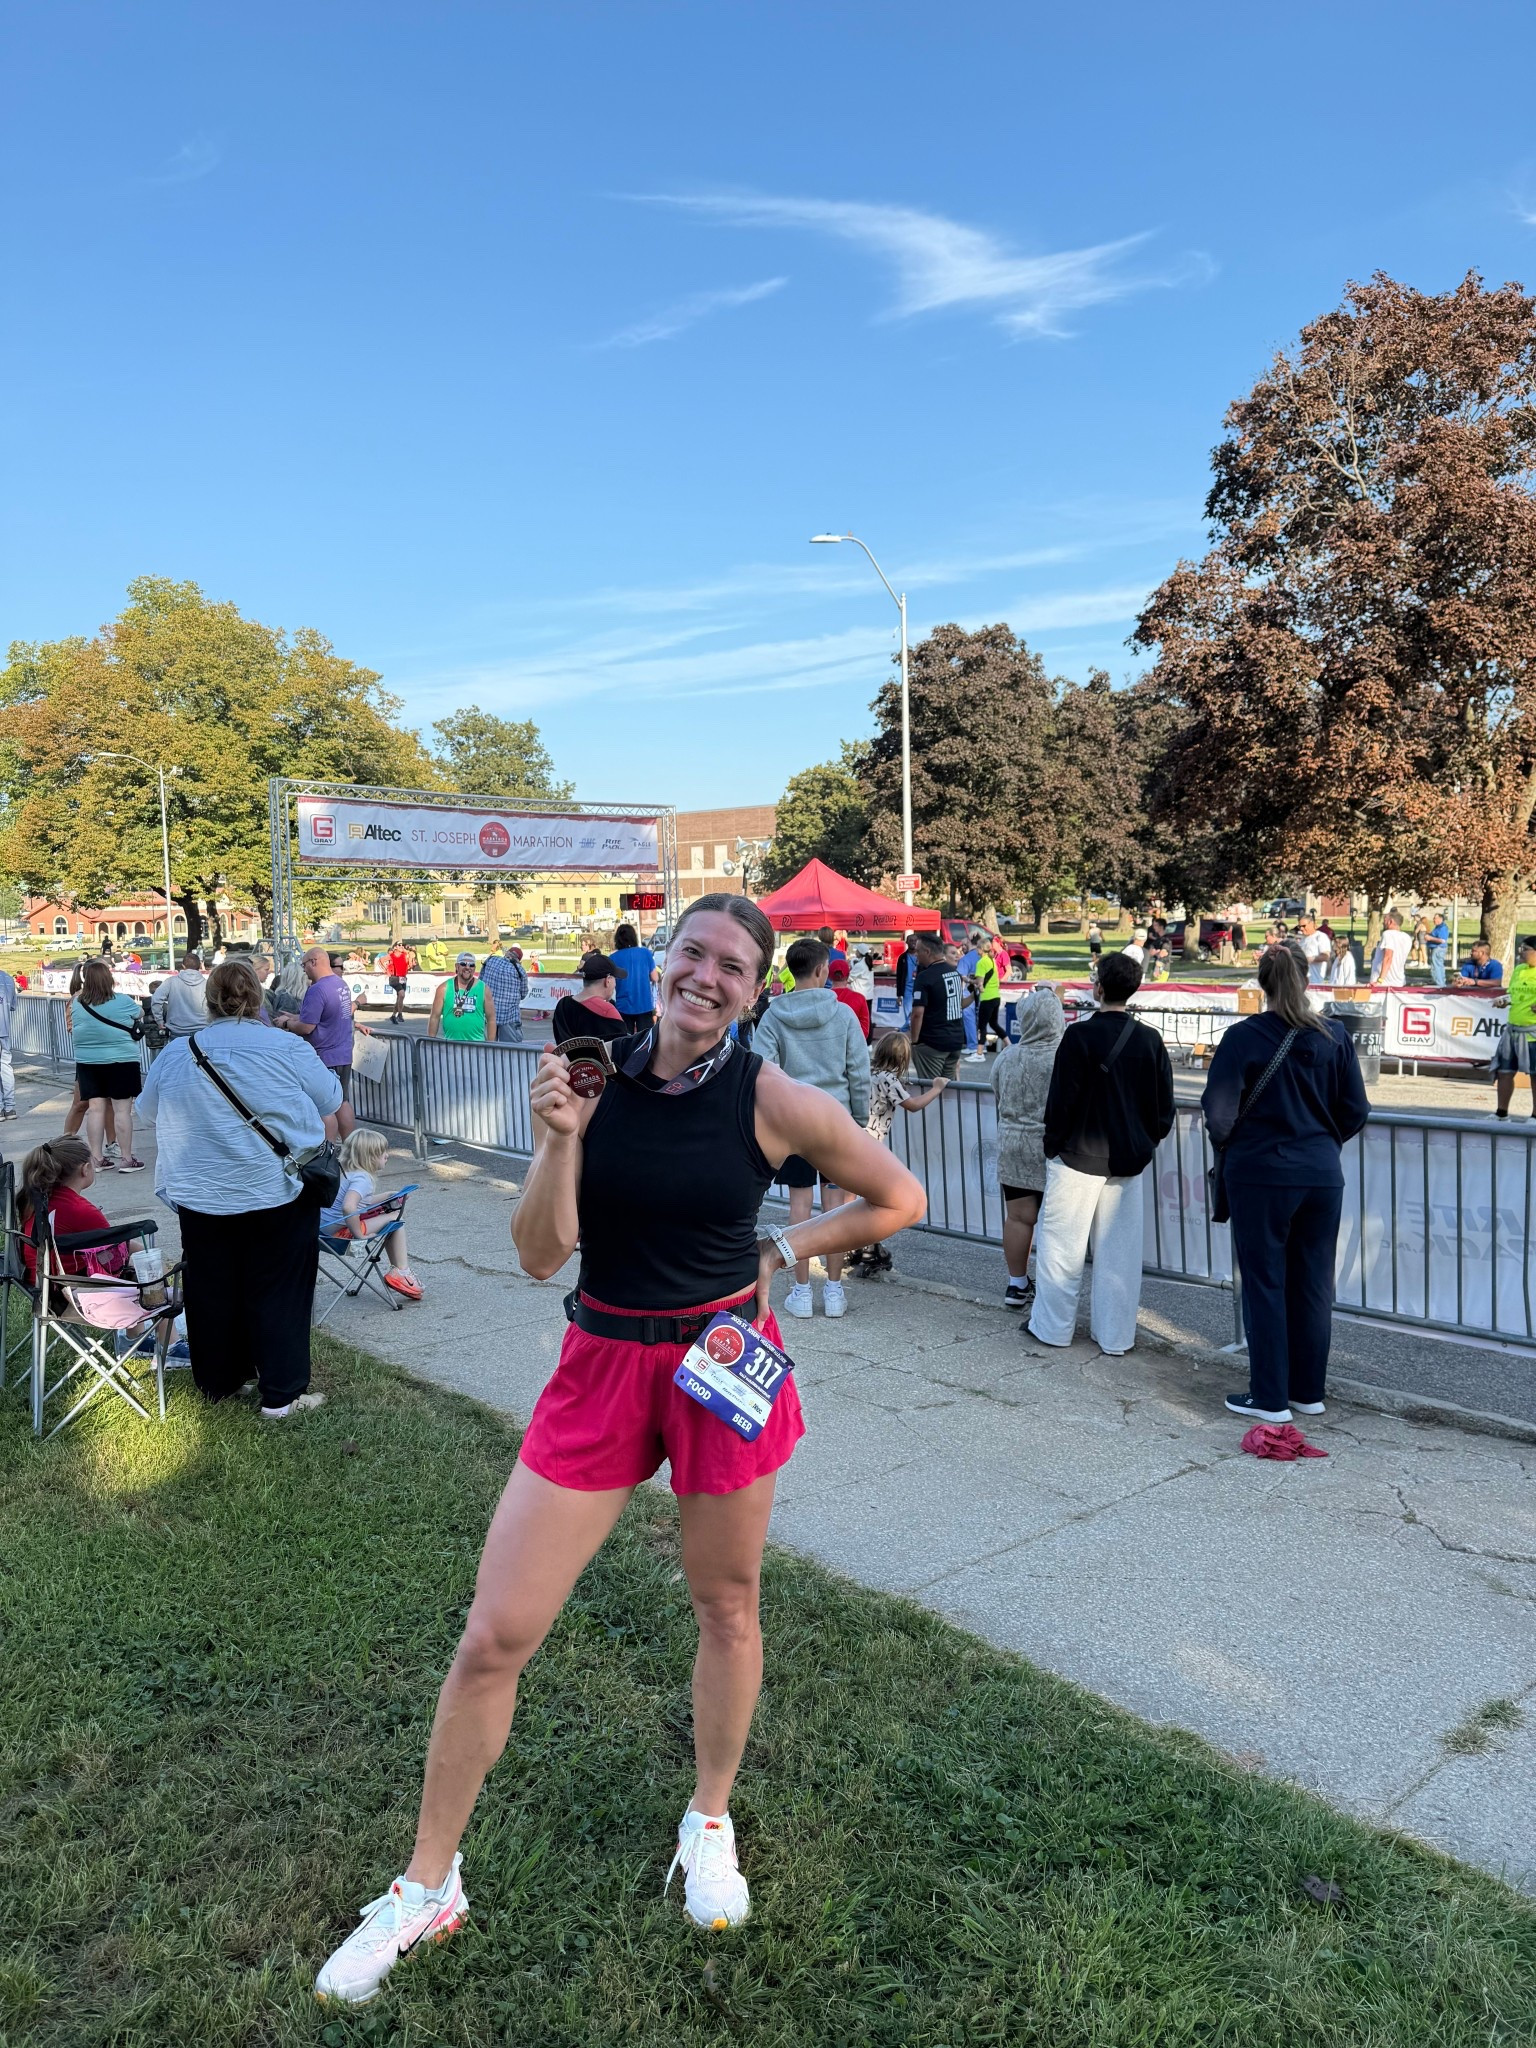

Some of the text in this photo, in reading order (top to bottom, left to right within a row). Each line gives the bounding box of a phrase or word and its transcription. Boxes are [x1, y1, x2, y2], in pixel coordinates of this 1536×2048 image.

[364, 824, 402, 842] Altec
[411, 829, 428, 843] ST.
[432, 831, 477, 845] JOSEPH
[513, 836, 573, 848] MARATHON
[1401, 1036, 1431, 1044] GRAY
[745, 1346, 783, 1390] 317
[686, 1378, 712, 1401] FOOD
[731, 1412, 753, 1433] BEER
